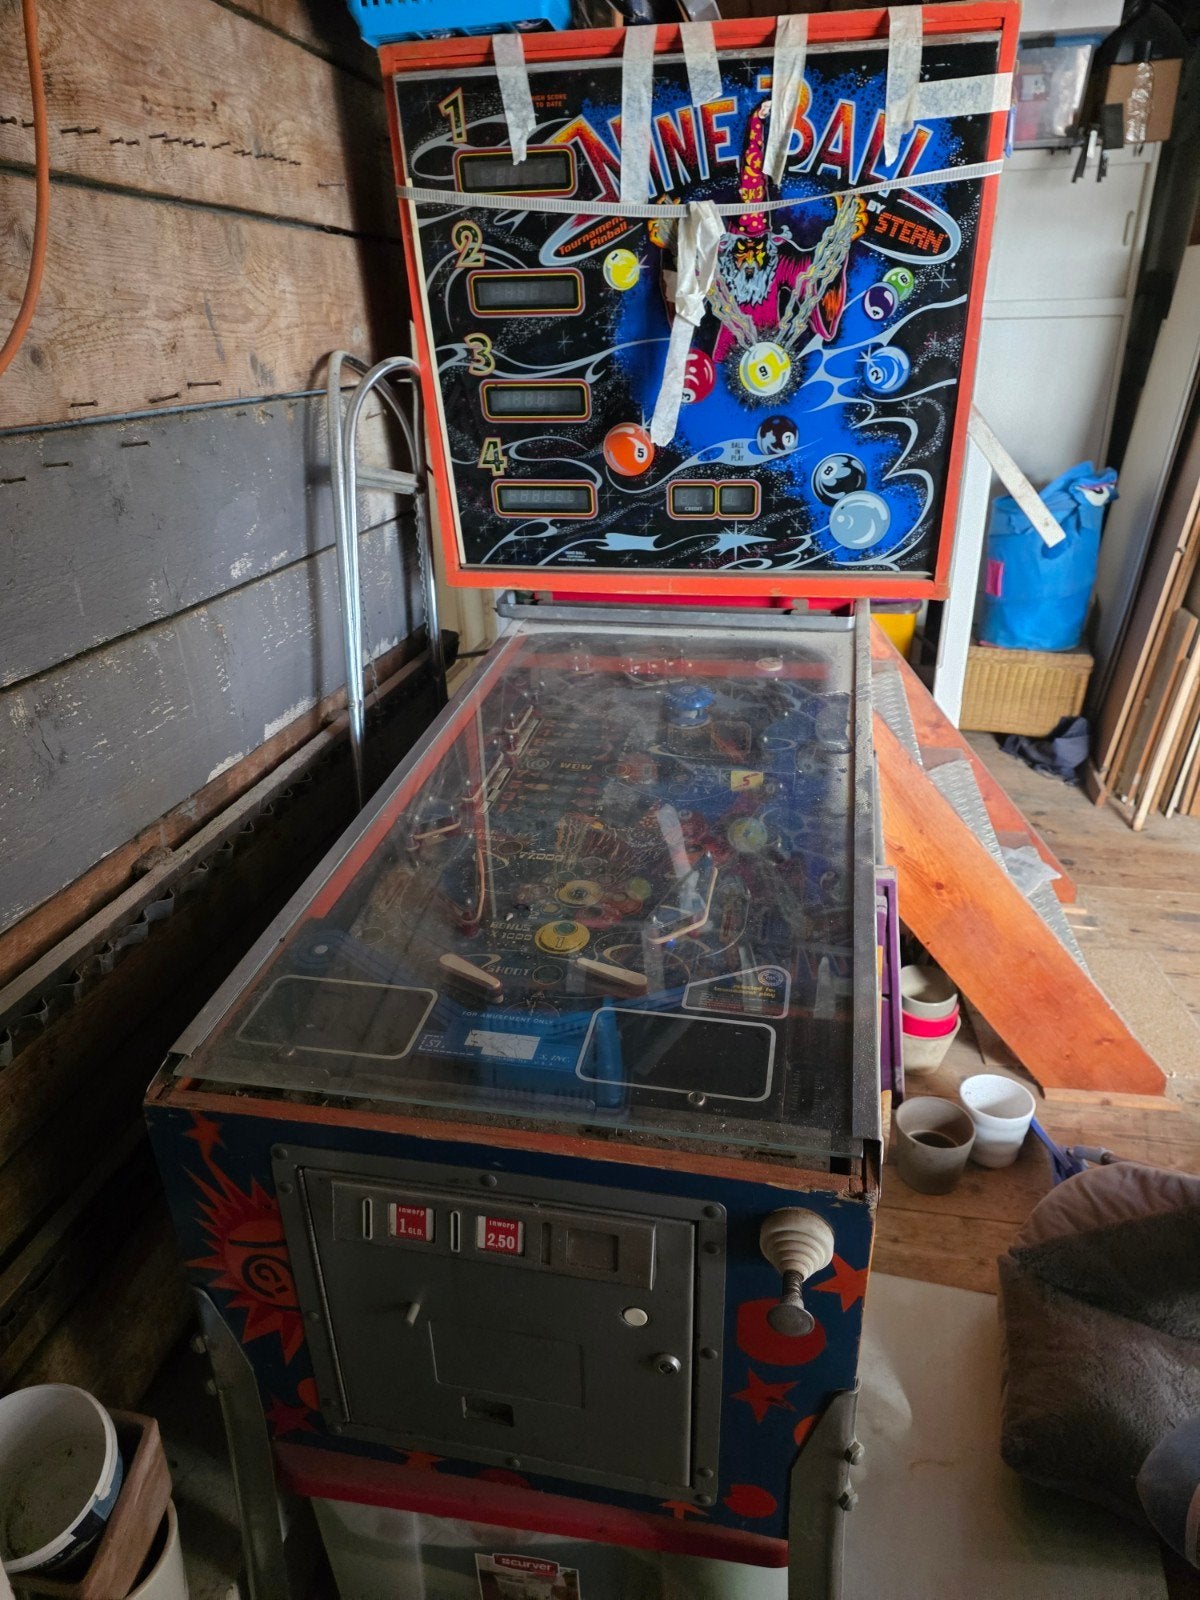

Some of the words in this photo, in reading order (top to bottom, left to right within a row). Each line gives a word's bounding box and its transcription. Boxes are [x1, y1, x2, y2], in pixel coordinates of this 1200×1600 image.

[546, 93, 568, 101] SCORE
[438, 87, 467, 144] 1
[866, 199, 886, 214] BY
[589, 221, 628, 249] Pinball
[874, 212, 945, 254] STERN
[451, 219, 485, 268] 2
[899, 274, 908, 284] 6
[872, 309, 880, 317] 4
[464, 332, 495, 376] 3
[759, 365, 768, 380] 9
[871, 369, 881, 381] 2
[731, 441, 744, 449] BALL
[477, 437, 508, 476] 4
[637, 447, 645, 458] 5
[730, 454, 745, 462] PLAY
[824, 465, 832, 476] 8
[560, 762, 593, 770] WOW
[490, 921, 533, 932] BONUS
[501, 931, 533, 941] 1000
[486, 964, 532, 976] SHOOT
[481, 1012, 531, 1024] AMUSEMENT
[399, 1218, 406, 1234] 1
[487, 1233, 516, 1250] 2.50
[510, 1559, 552, 1571] curver
